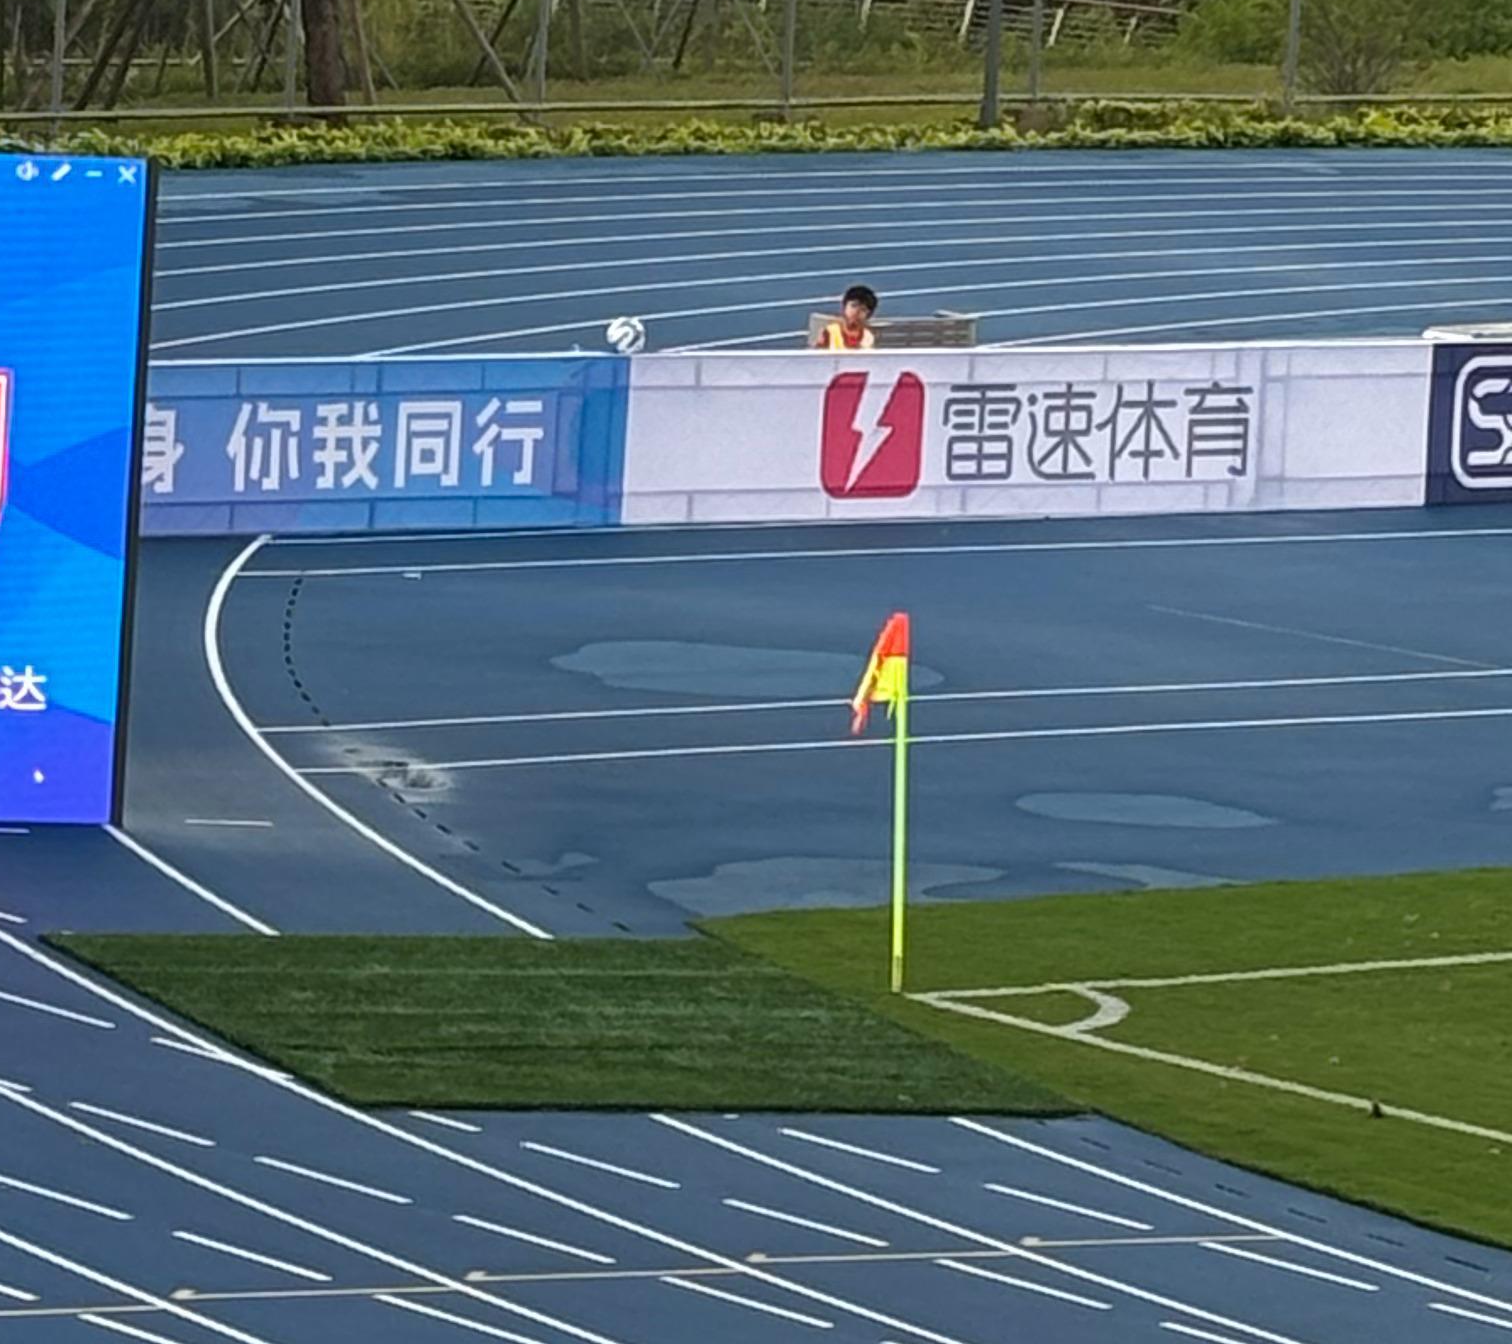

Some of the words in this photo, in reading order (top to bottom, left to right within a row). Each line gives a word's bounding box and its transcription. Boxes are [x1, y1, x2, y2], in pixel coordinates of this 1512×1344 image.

[226, 397, 544, 493] 你我同行
[942, 380, 1255, 482] 雷速体育
